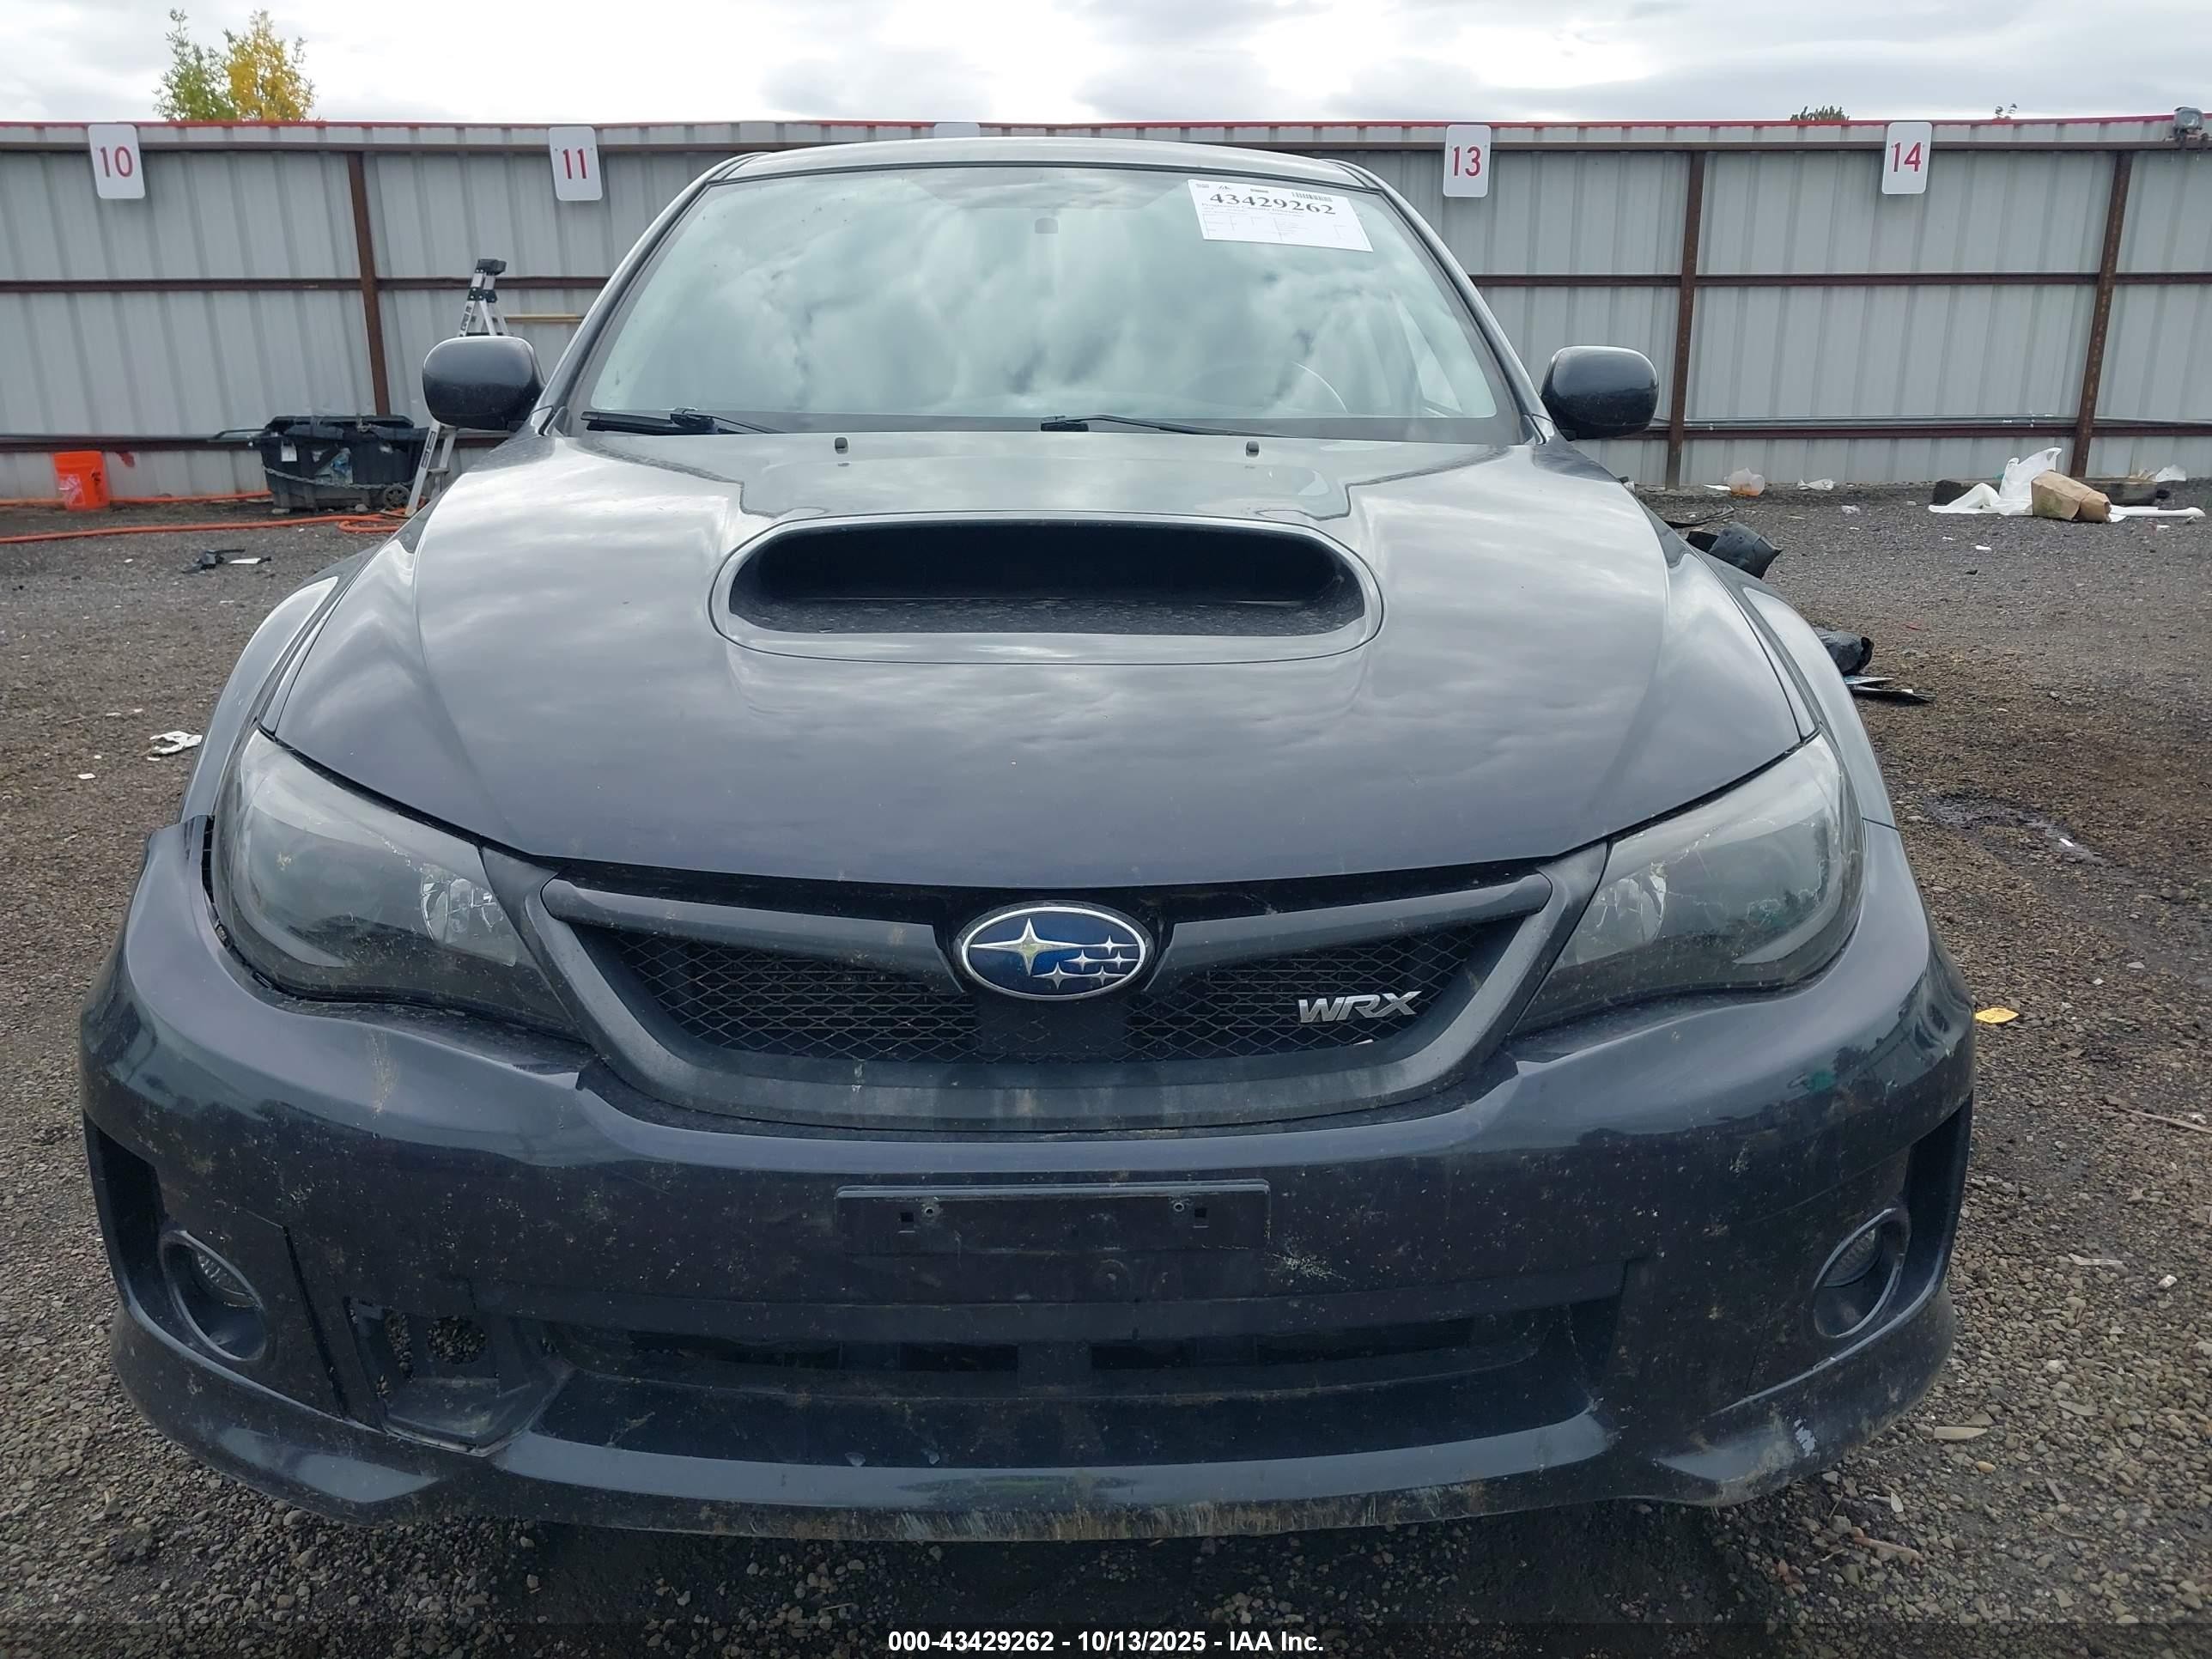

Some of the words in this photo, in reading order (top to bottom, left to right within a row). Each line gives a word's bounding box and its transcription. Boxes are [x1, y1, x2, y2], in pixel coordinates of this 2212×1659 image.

[100, 146, 133, 178] 10
[562, 148, 587, 179] 11
[1453, 145, 1481, 177] 13
[1893, 142, 1922, 173] 14
[1209, 192, 1336, 216] 43429262
[1298, 991, 1422, 1024] WRX
